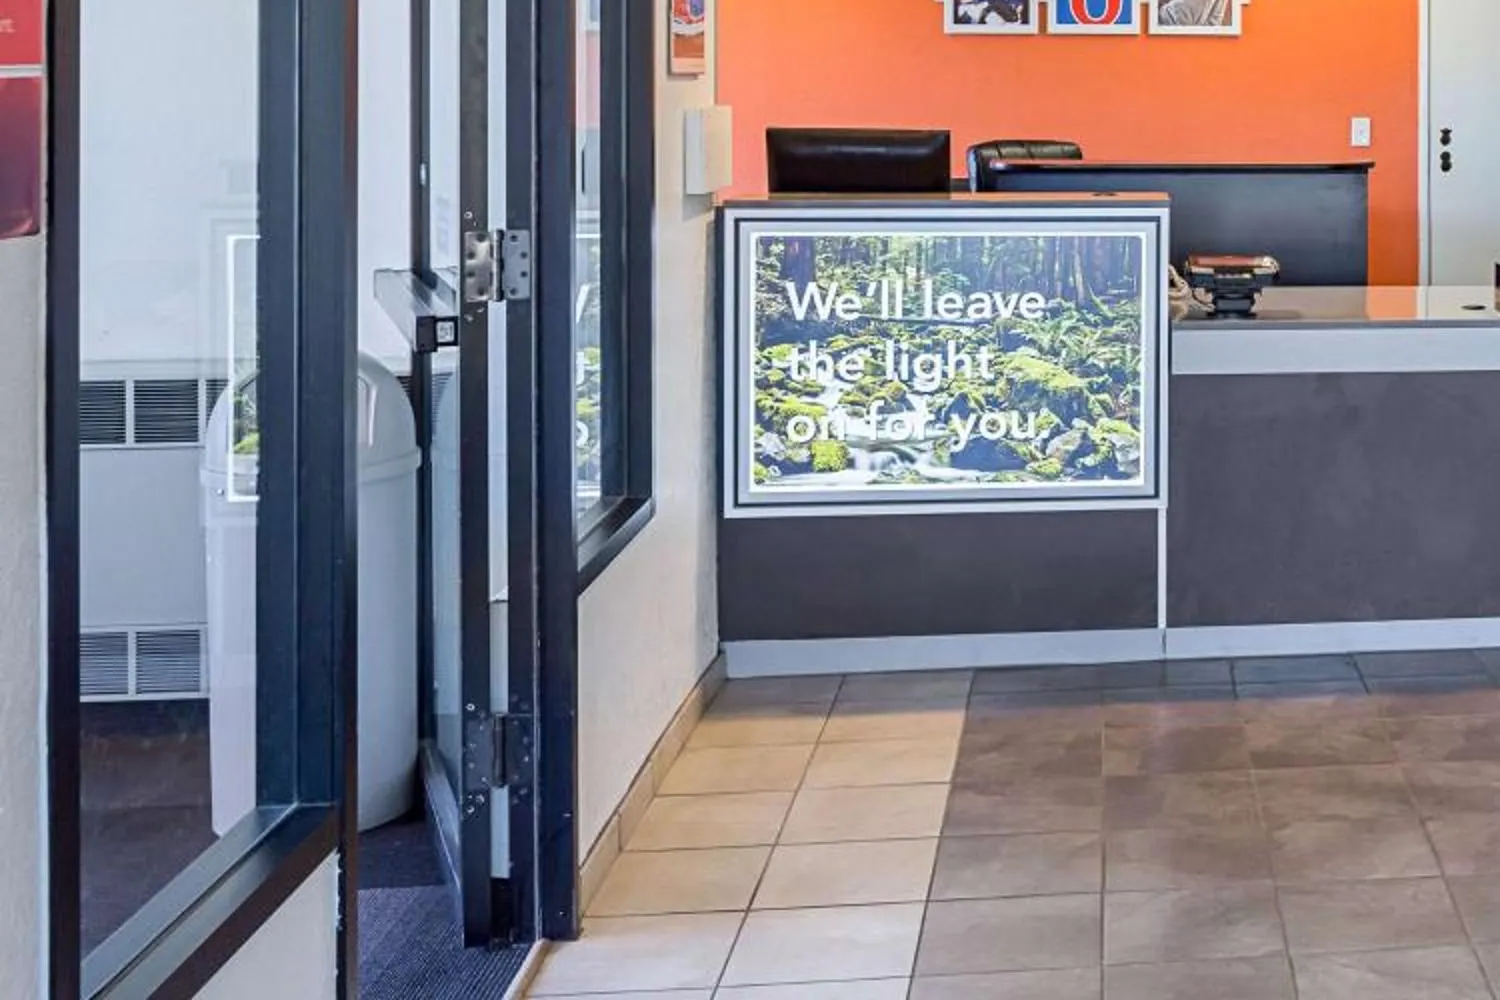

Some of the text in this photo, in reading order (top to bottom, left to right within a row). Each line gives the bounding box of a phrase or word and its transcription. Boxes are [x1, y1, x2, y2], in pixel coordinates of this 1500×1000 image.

[786, 280, 1046, 321] We'll leave
[789, 340, 996, 393] the light
[786, 411, 846, 443] on
[863, 400, 937, 441] for
